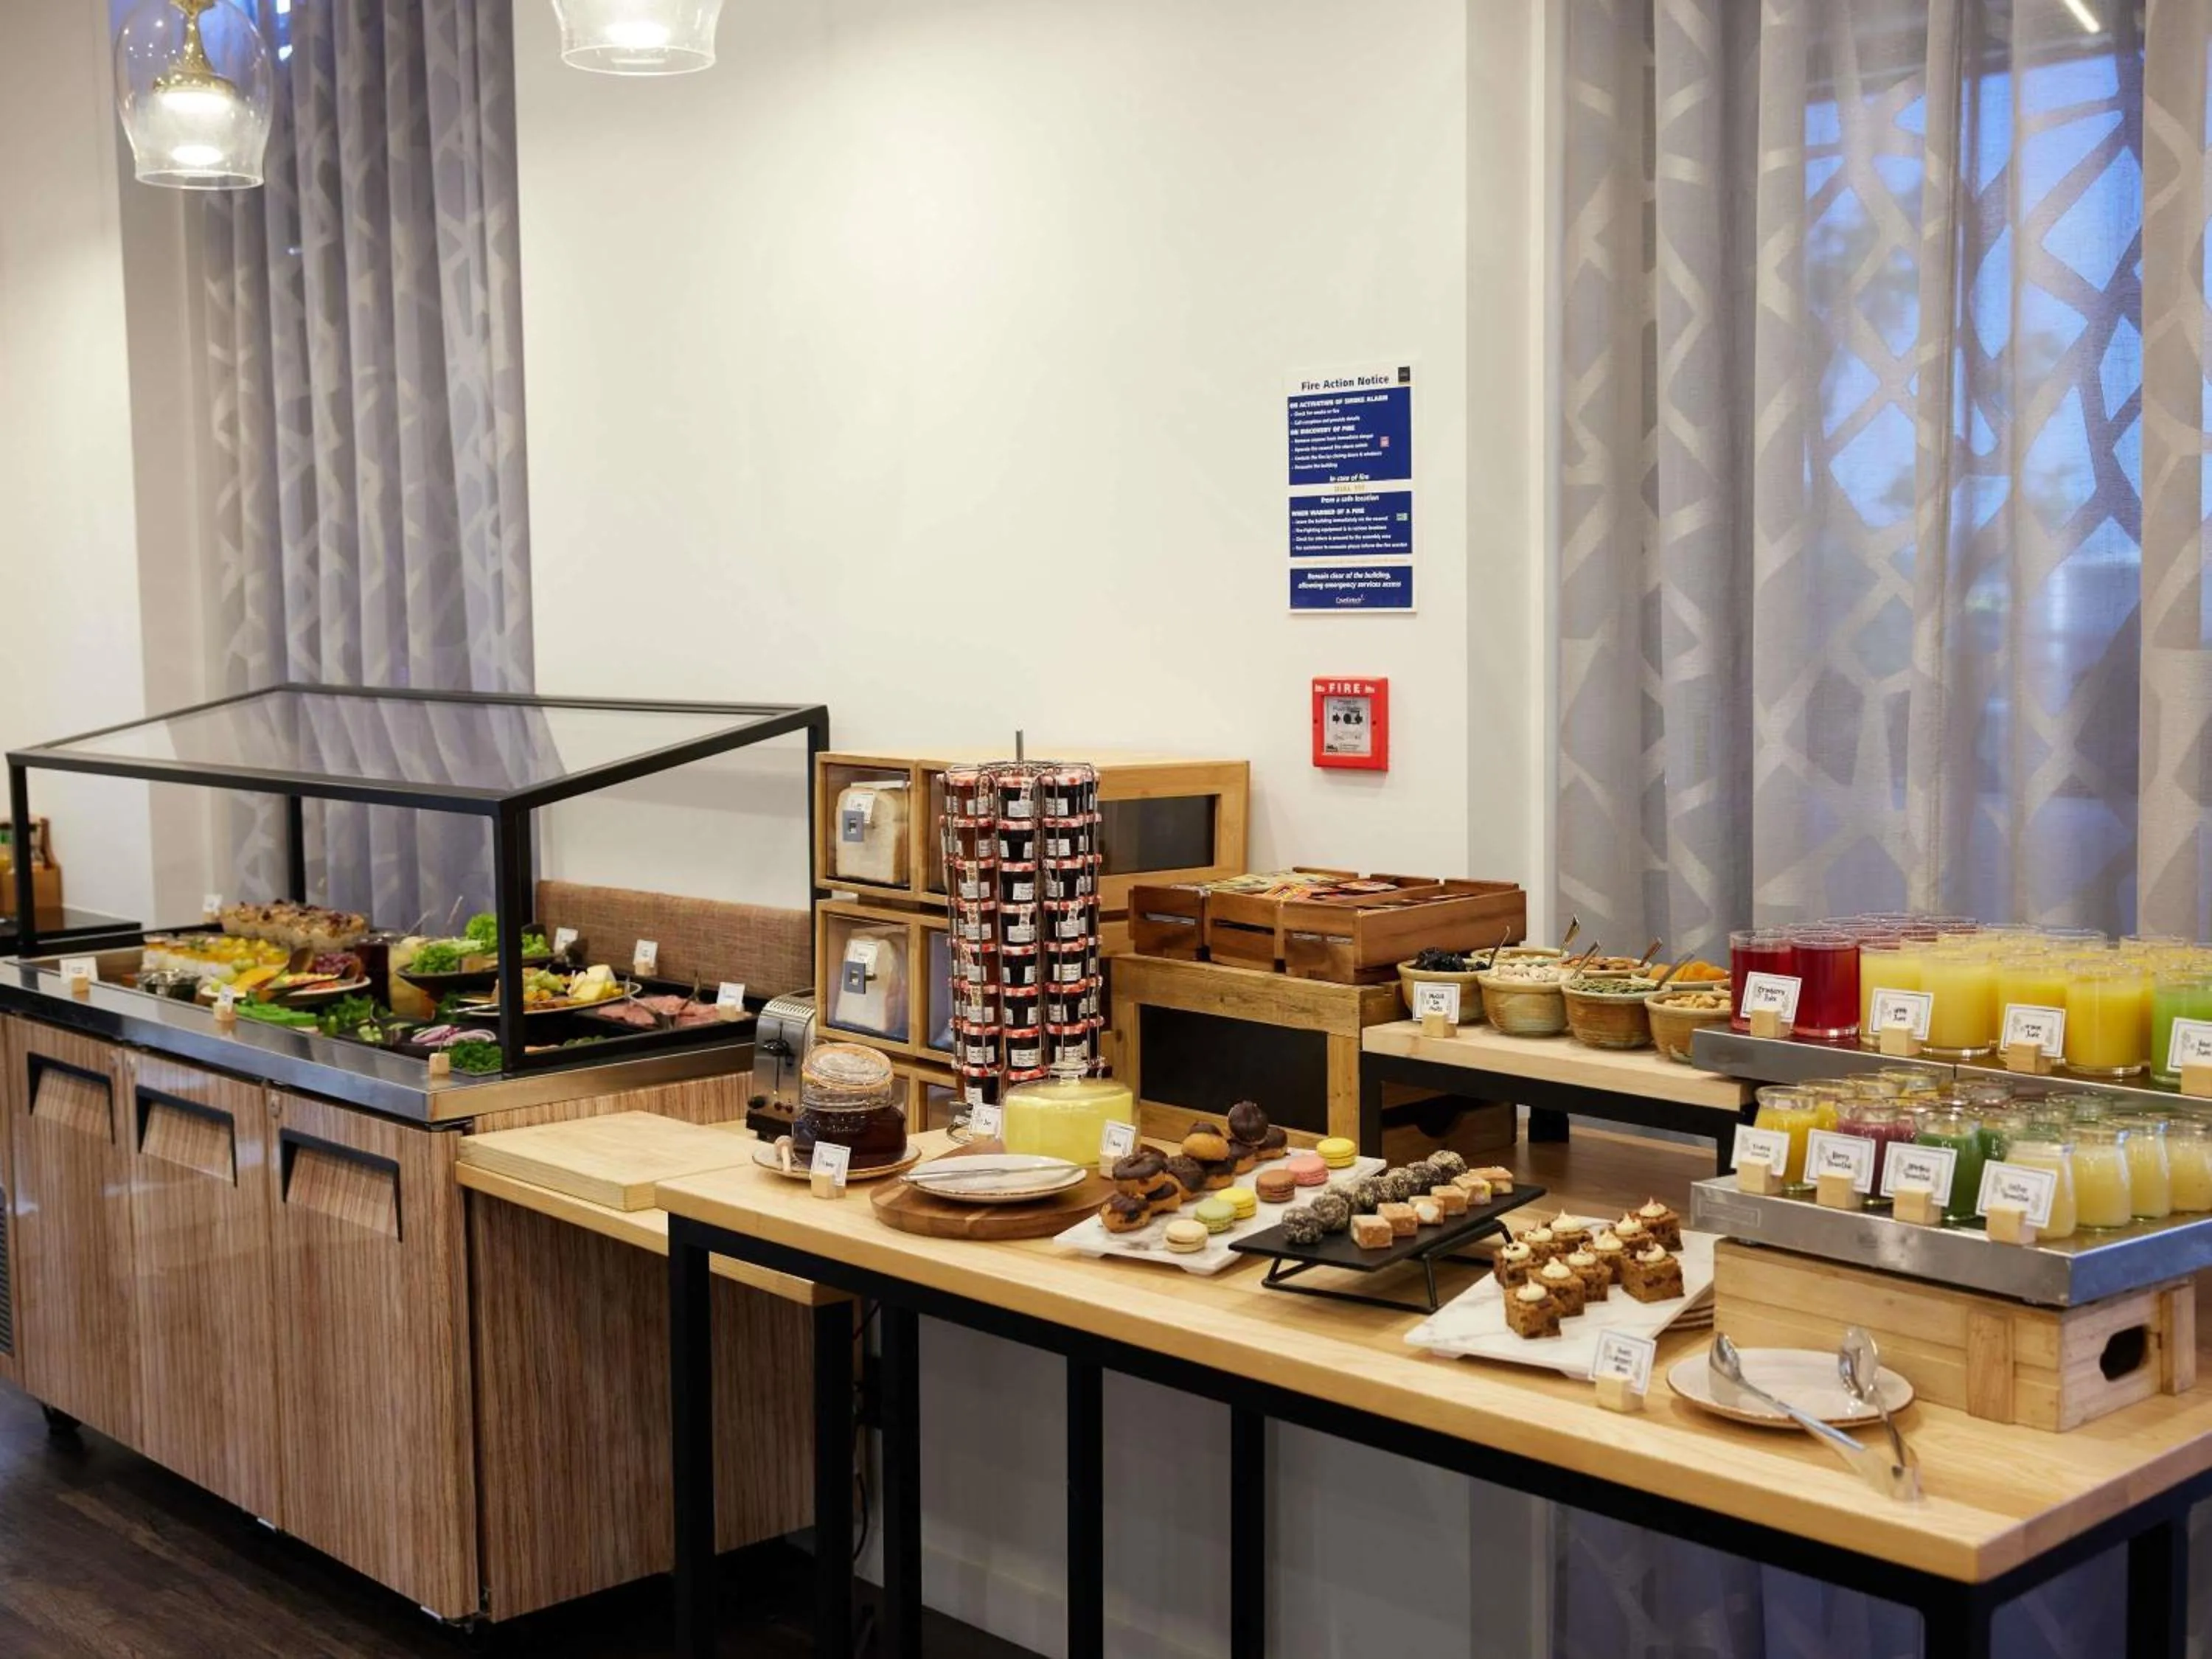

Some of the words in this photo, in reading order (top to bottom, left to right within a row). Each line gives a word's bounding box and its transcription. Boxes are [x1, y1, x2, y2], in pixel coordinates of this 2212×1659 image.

[1301, 381, 1320, 391] Fire
[1324, 378, 1354, 389] Action
[1357, 375, 1389, 385] Notice
[1351, 473, 1358, 481] of
[1329, 683, 1360, 694] FIRE
